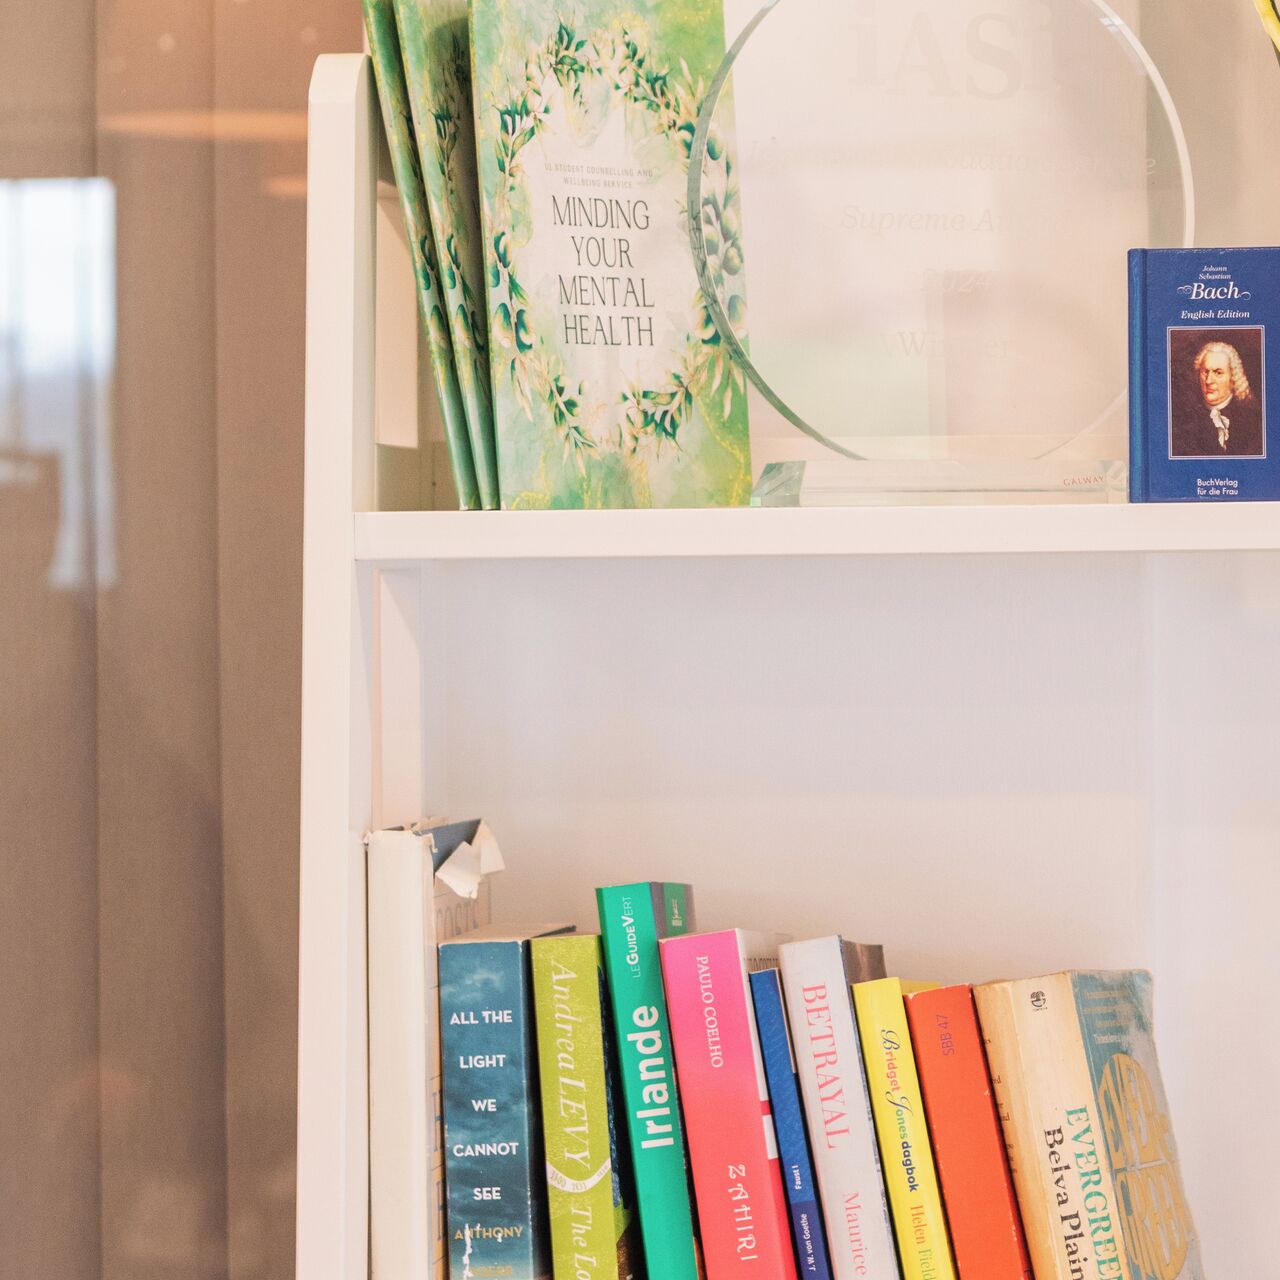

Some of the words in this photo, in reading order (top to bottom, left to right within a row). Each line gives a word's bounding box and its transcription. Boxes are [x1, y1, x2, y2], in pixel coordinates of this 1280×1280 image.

[552, 195, 650, 230] MINDING
[571, 236, 634, 268] YOUR
[558, 274, 655, 308] MENTAL
[1191, 282, 1240, 300] Bach
[563, 314, 654, 346] HEALTH
[1181, 310, 1215, 320] English
[1217, 309, 1250, 319] Edition
[1197, 478, 1238, 488] BuchVerlag
[1197, 487, 1207, 495] für
[1208, 487, 1221, 495] die
[1222, 487, 1239, 496] Frau
[696, 956, 714, 1004] PAULO
[450, 1012, 478, 1025] ALL
[482, 1010, 512, 1023] THE
[551, 959, 582, 1070] Andrea
[936, 1014, 949, 1030] 47
[704, 1006, 723, 1068] COELHO
[940, 1032, 955, 1056] SBB
[460, 1055, 506, 1069] LIGHT
[802, 982, 850, 1150] BETRAYAL
[881, 1029, 900, 1092] Bridget
[627, 1005, 674, 1149] Irlande
[472, 1099, 497, 1112] WE
[886, 1091, 913, 1140] Jones
[559, 1077, 590, 1170] LEVY
[453, 1143, 519, 1157] CANNOT
[1043, 1125, 1071, 1207] Belva
[793, 1172, 801, 1190] Faust
[901, 1141, 919, 1192] dagbok
[473, 1187, 501, 1200] SEE
[571, 1205, 592, 1248] The
[801, 1214, 812, 1237] Goethe
[843, 1192, 869, 1276] Maurice
[910, 1205, 928, 1244] Helen
[806, 1237, 814, 1250] von
[808, 1252, 816, 1264] W.
